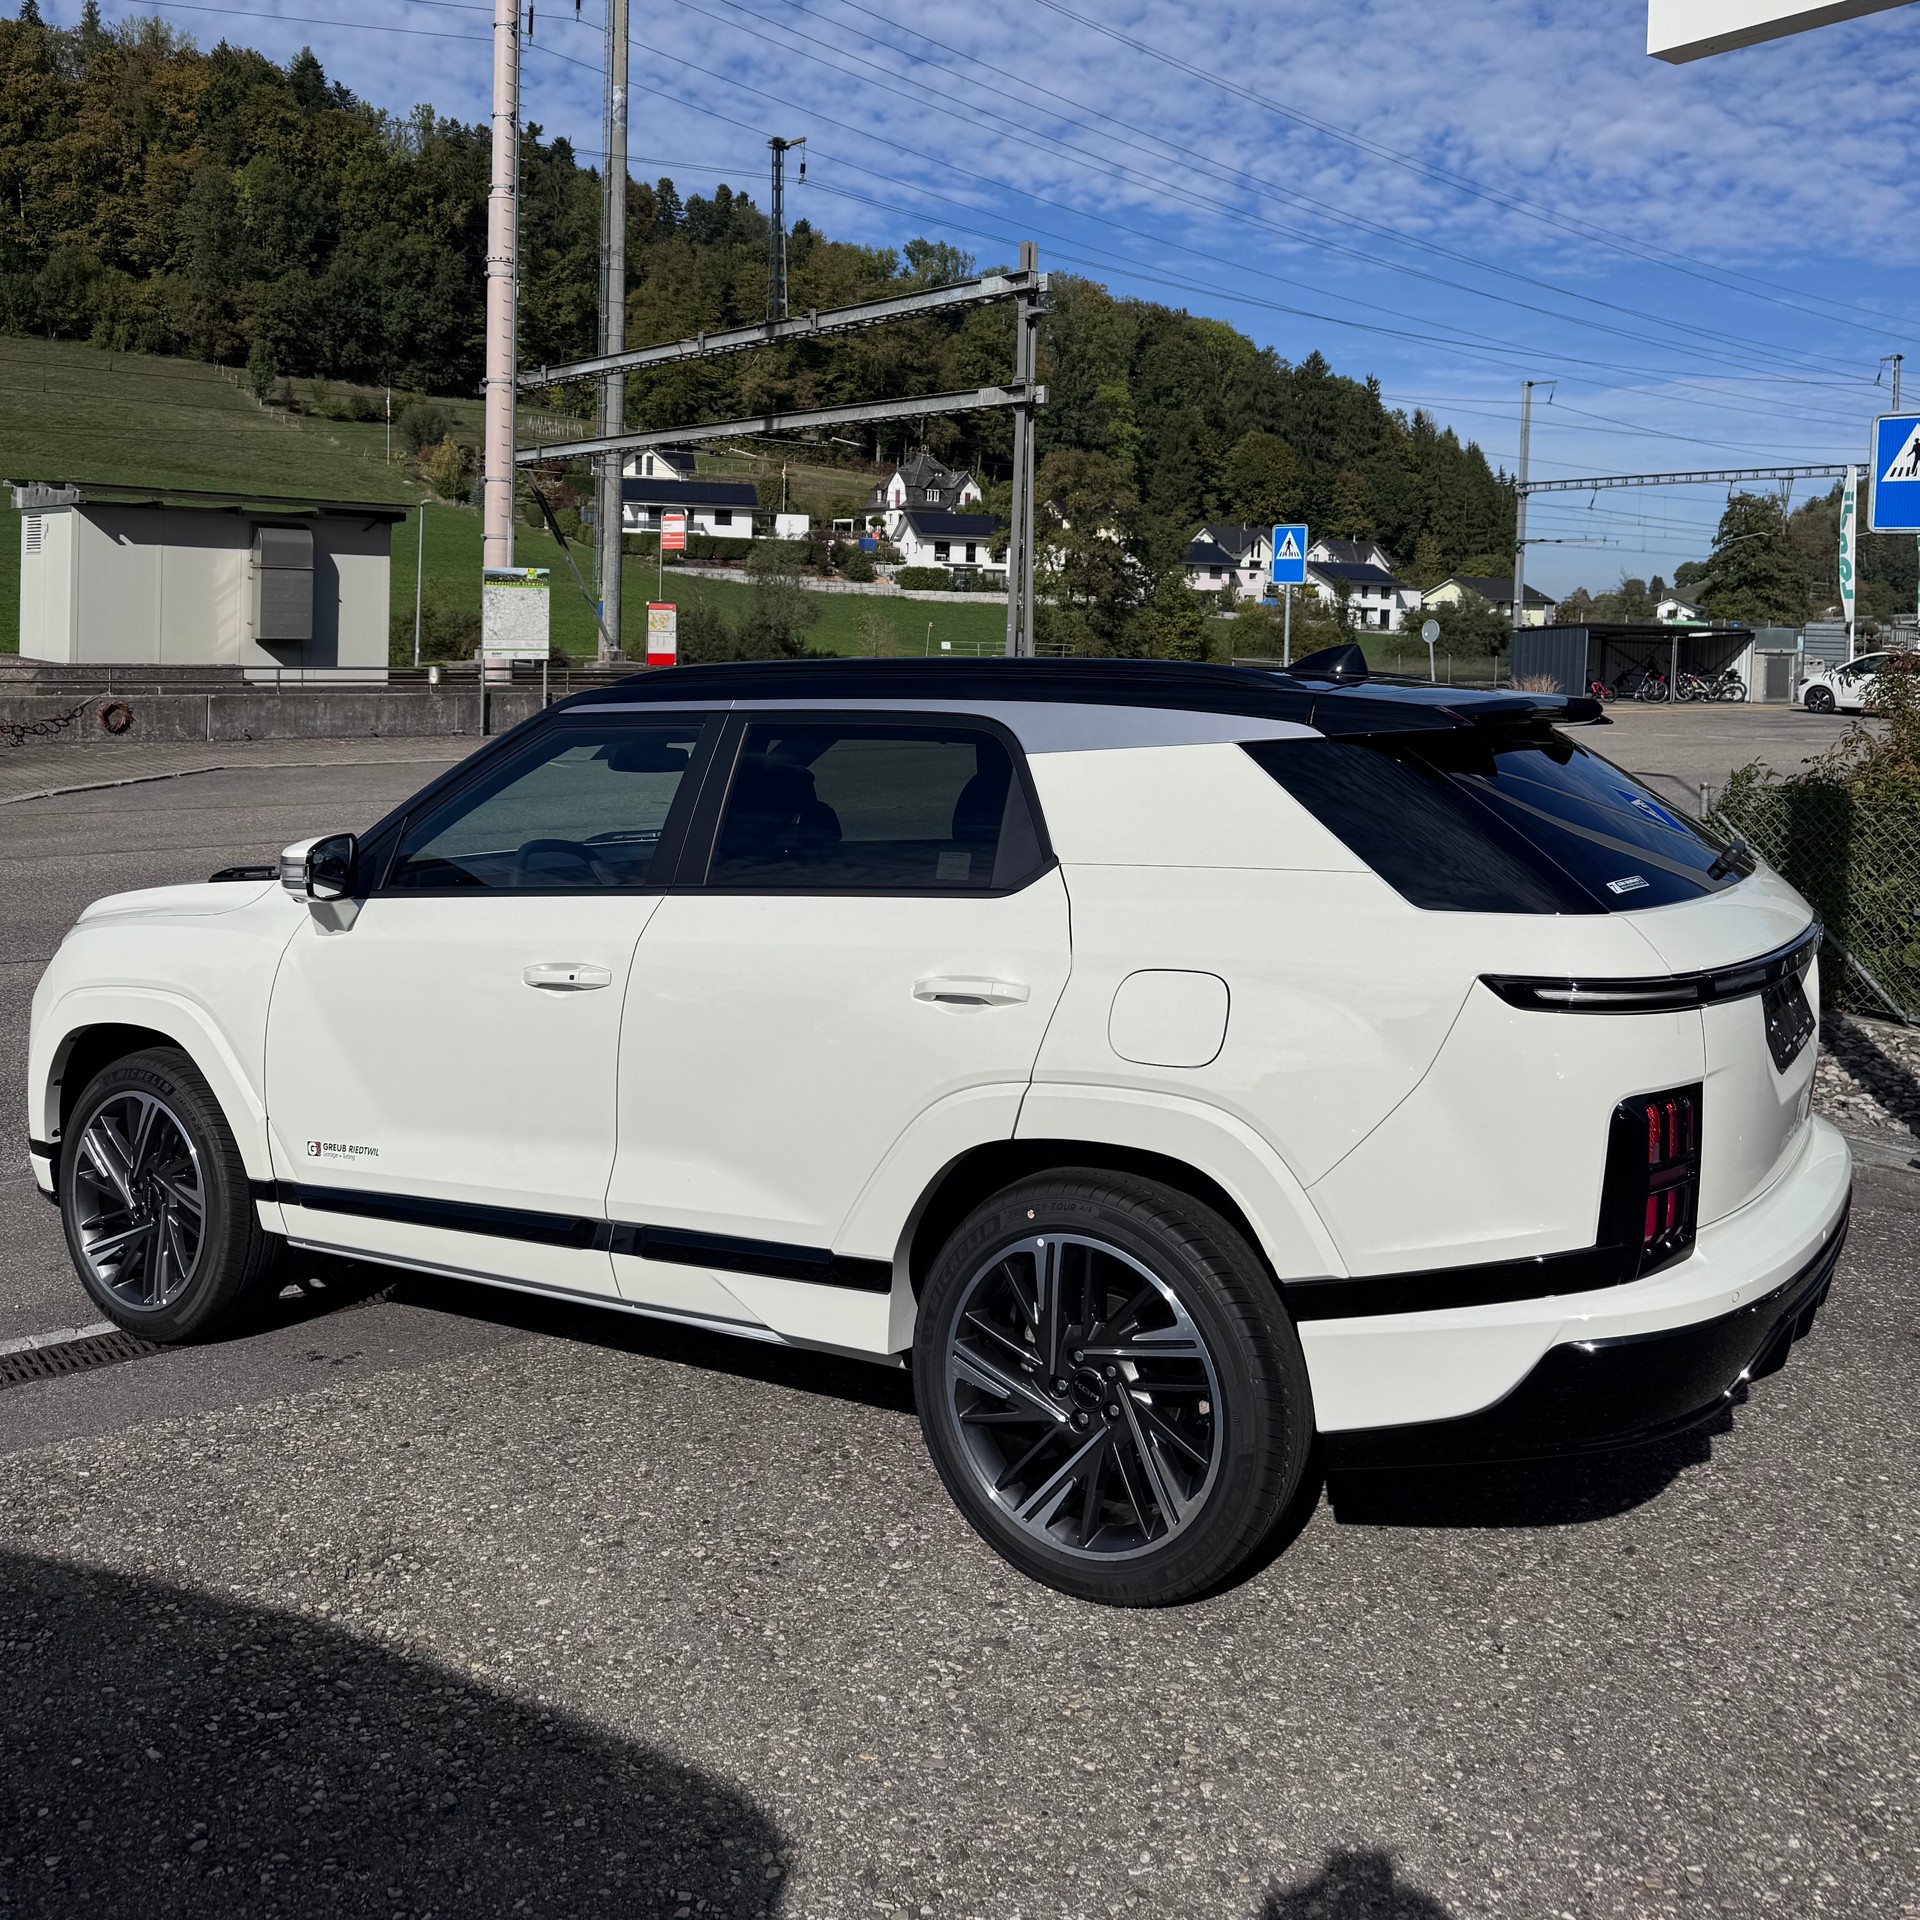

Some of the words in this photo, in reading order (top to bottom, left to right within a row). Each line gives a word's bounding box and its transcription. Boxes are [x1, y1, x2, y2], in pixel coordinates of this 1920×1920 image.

[116, 1069, 172, 1093] MICHELIN
[323, 1143, 347, 1152] GREUB
[348, 1145, 379, 1156] RIEDTWIL
[323, 1151, 339, 1159] Garage
[1051, 1202, 1077, 1212] TOUR
[1074, 1380, 1100, 1402] KGM
